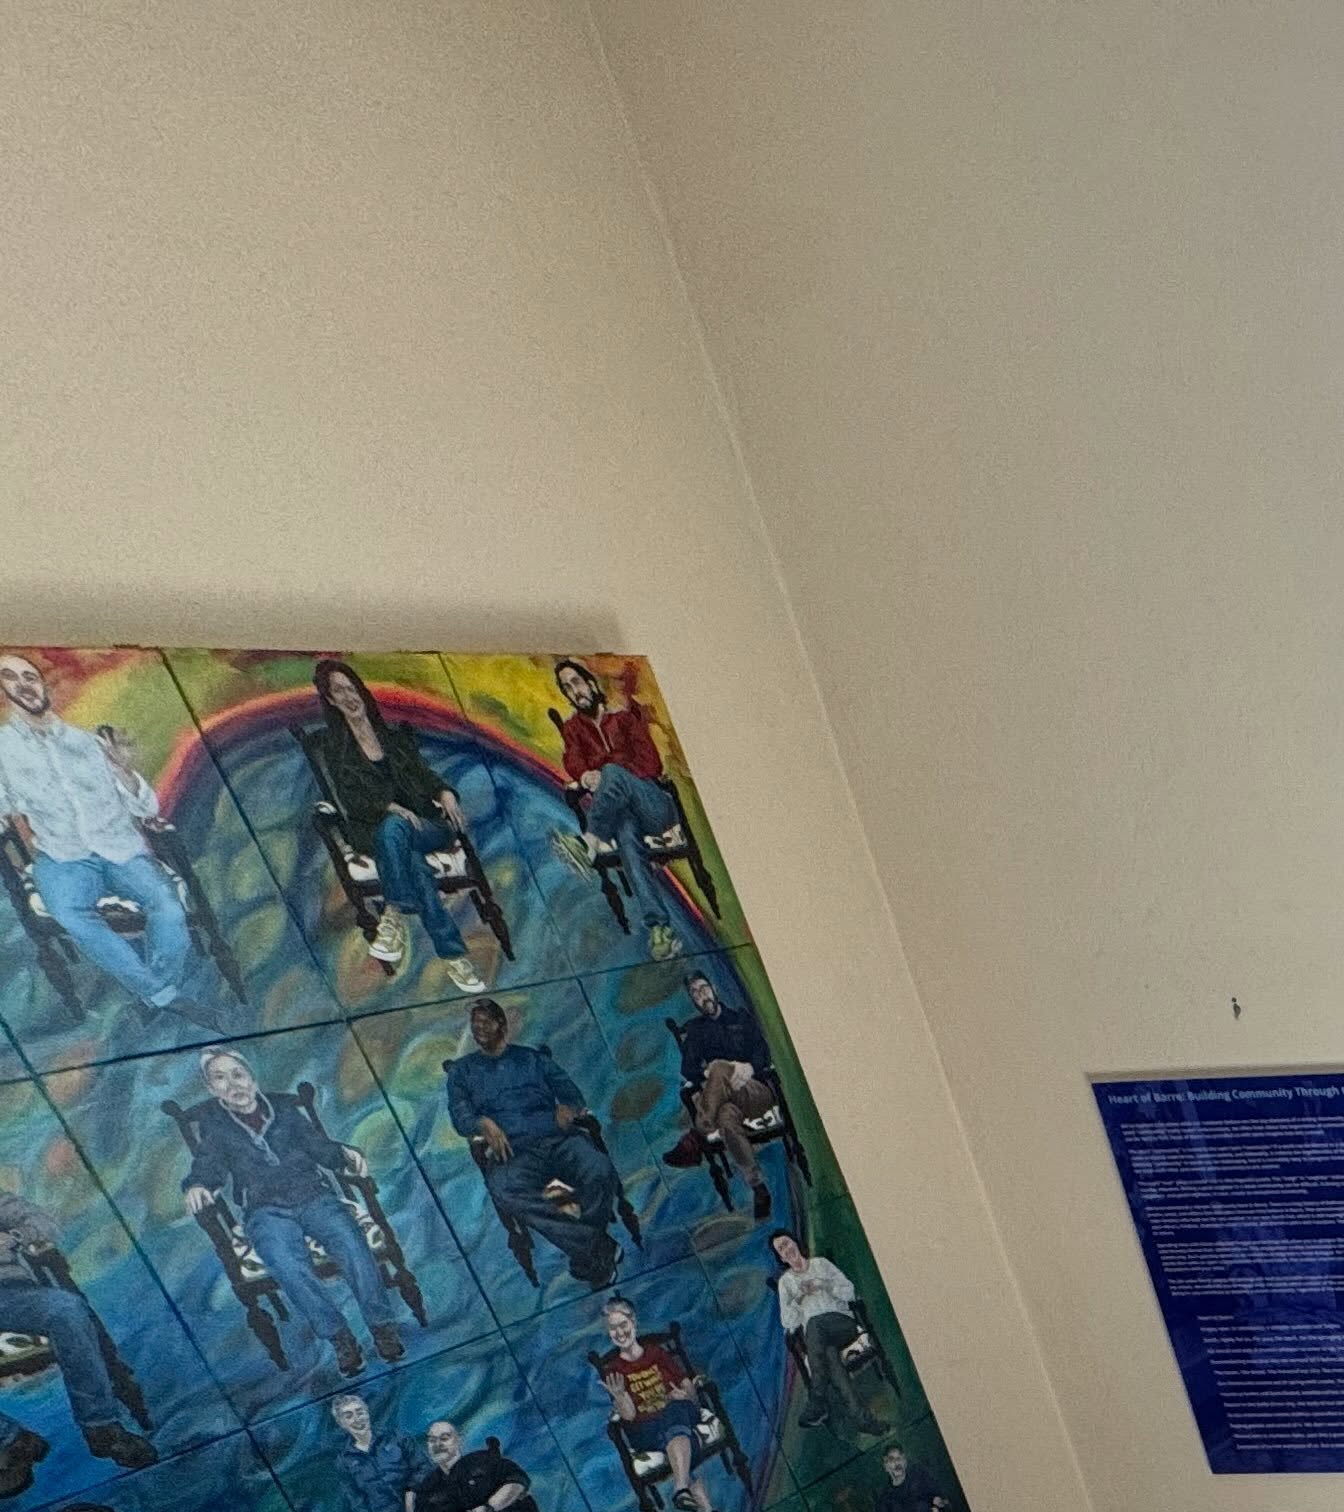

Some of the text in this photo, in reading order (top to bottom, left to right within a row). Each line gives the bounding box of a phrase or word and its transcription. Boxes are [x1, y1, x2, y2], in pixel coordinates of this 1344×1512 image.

[1108, 1095, 1139, 1104] Heart
[1141, 1091, 1152, 1103] of
[1187, 1091, 1231, 1102] Building
[1232, 1088, 1293, 1100] Community
[1295, 1085, 1339, 1098] Through
